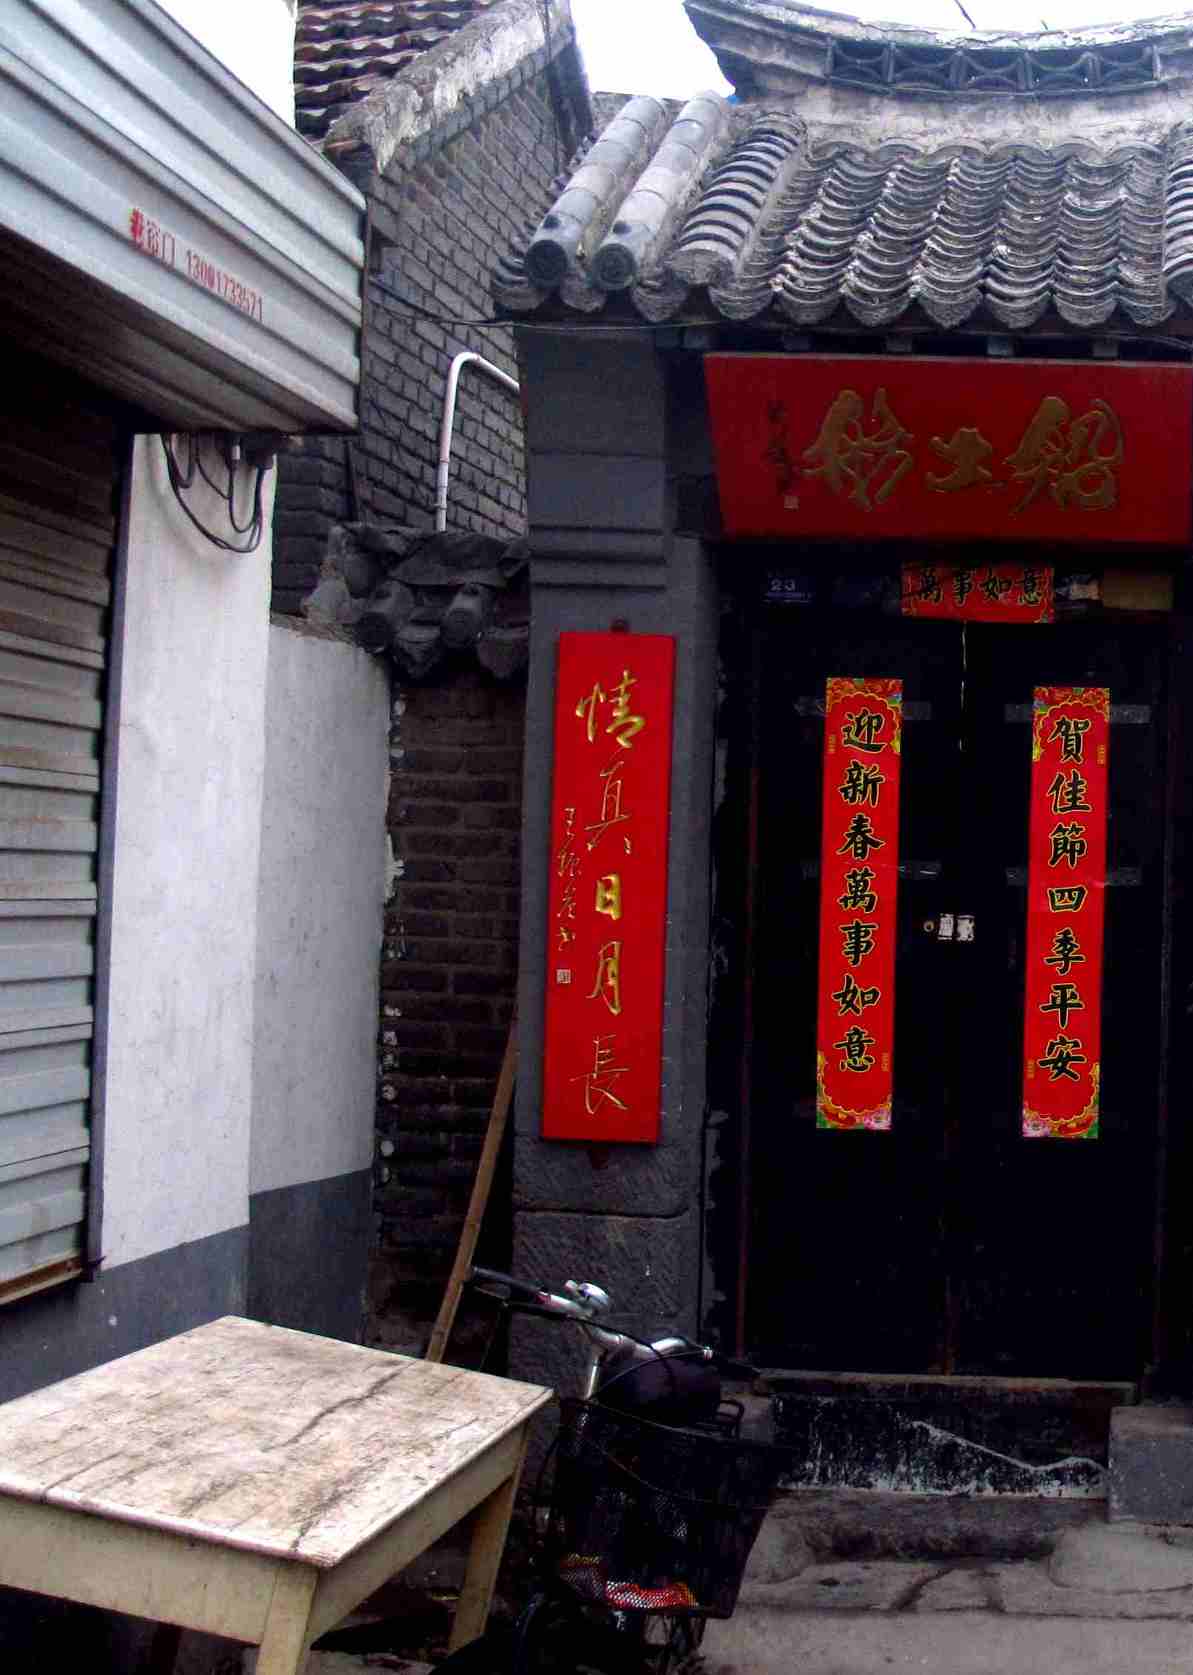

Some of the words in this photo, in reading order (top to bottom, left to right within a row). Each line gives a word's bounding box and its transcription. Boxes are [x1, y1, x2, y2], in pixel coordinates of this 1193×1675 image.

[917, 566, 1043, 608] 萬事如意
[831, 706, 886, 1073] 迎新春萬事如意
[1037, 714, 1093, 1082] 賀佳節四季平安
